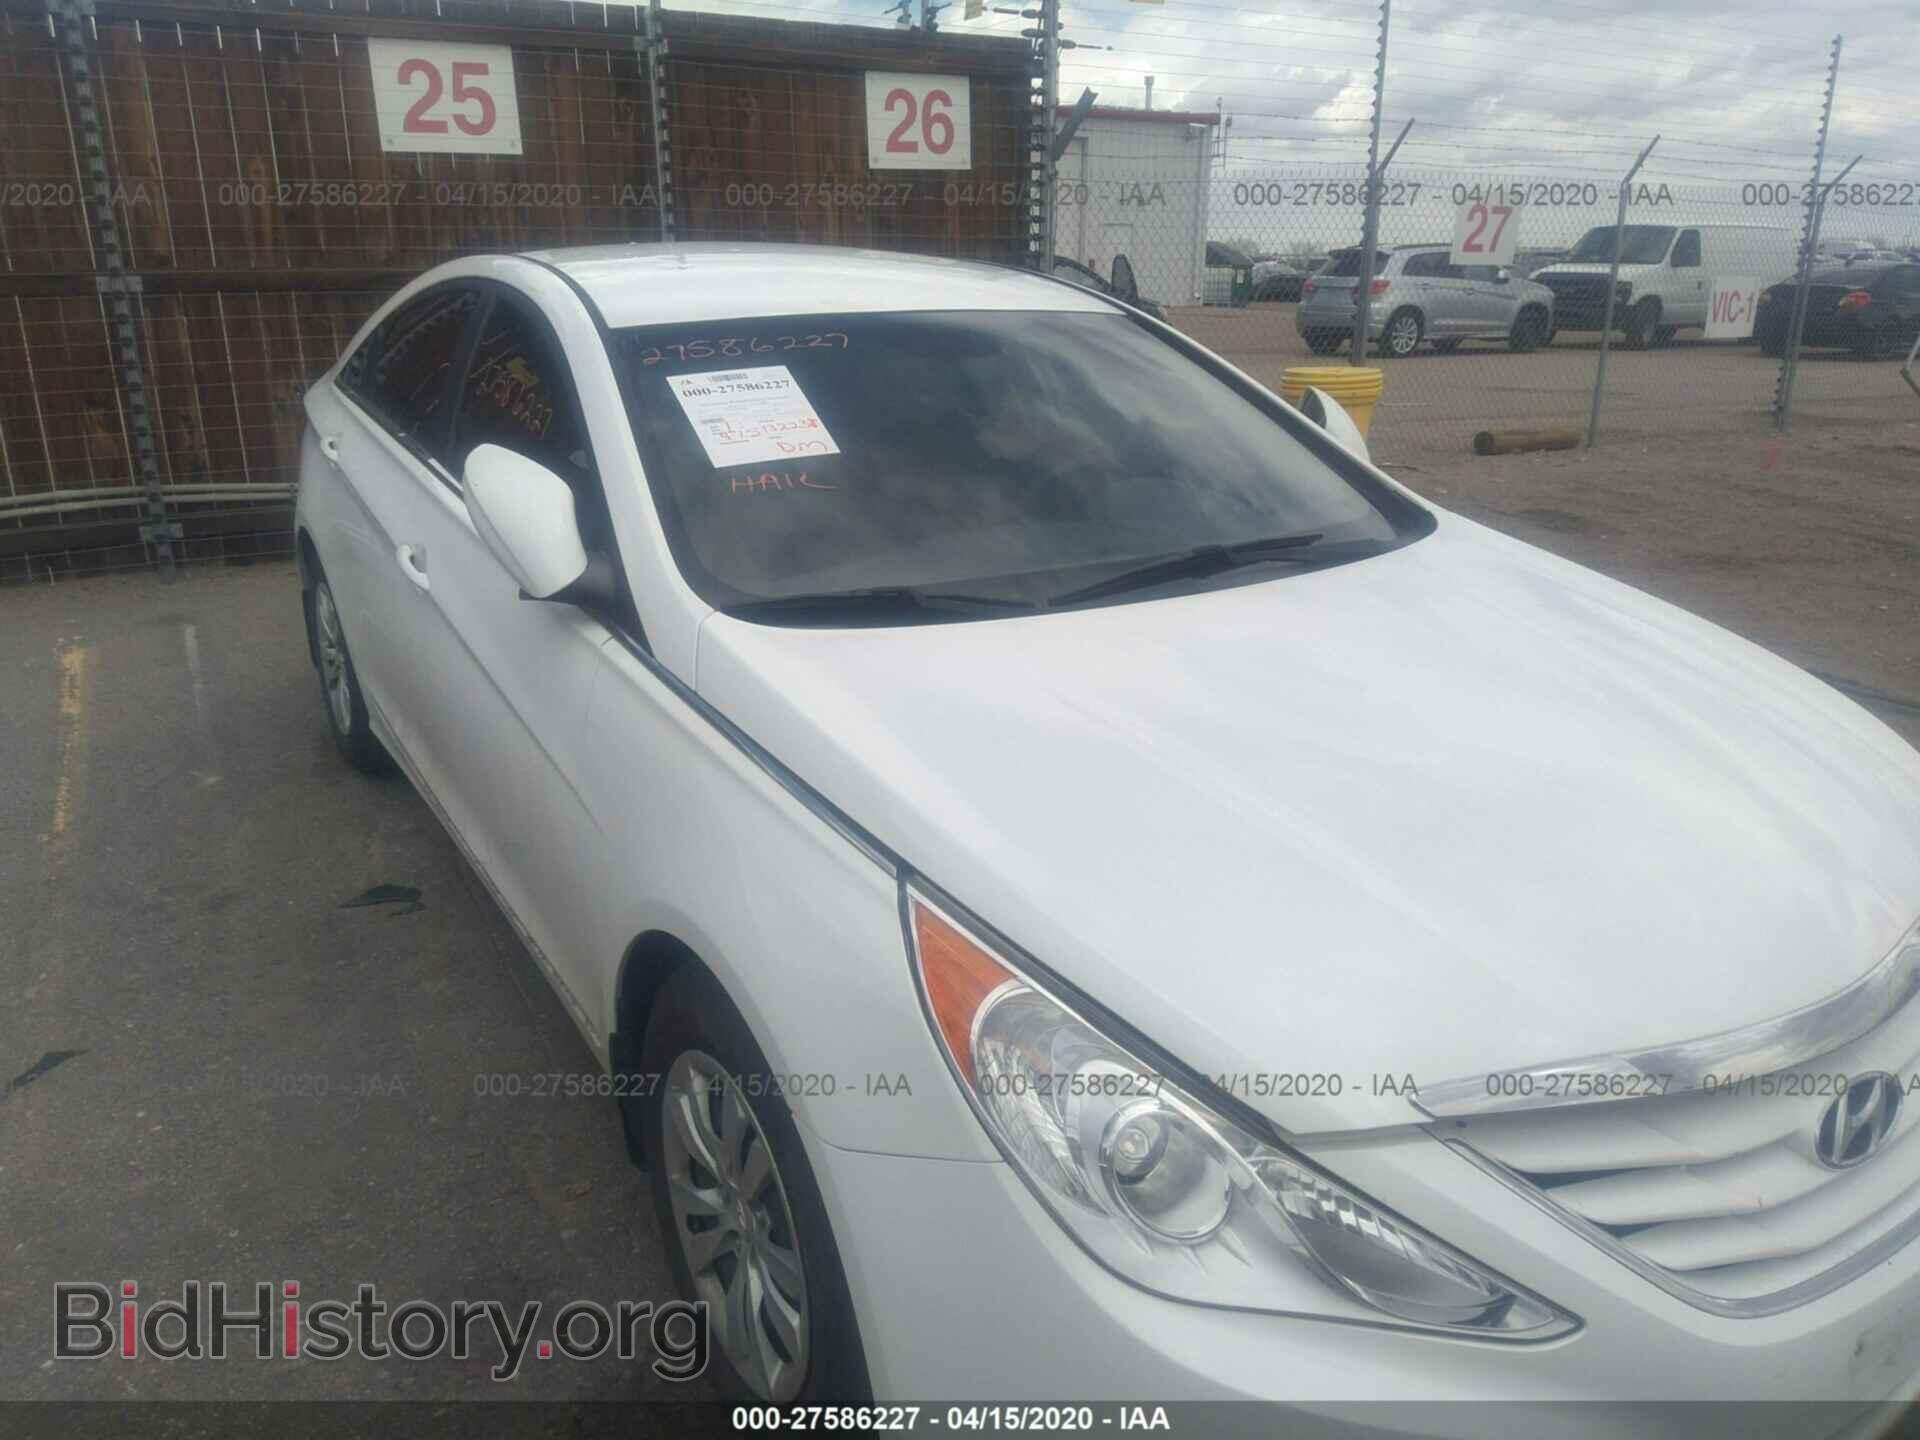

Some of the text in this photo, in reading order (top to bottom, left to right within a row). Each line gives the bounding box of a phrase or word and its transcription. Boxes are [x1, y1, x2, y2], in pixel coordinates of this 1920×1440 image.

[397, 58, 496, 136] 25
[883, 88, 955, 155] 26
[1461, 204, 1514, 254] 27
[1711, 290, 1755, 324] VIC-1
[641, 332, 849, 365] 27586227
[682, 379, 791, 398] 000-27586227
